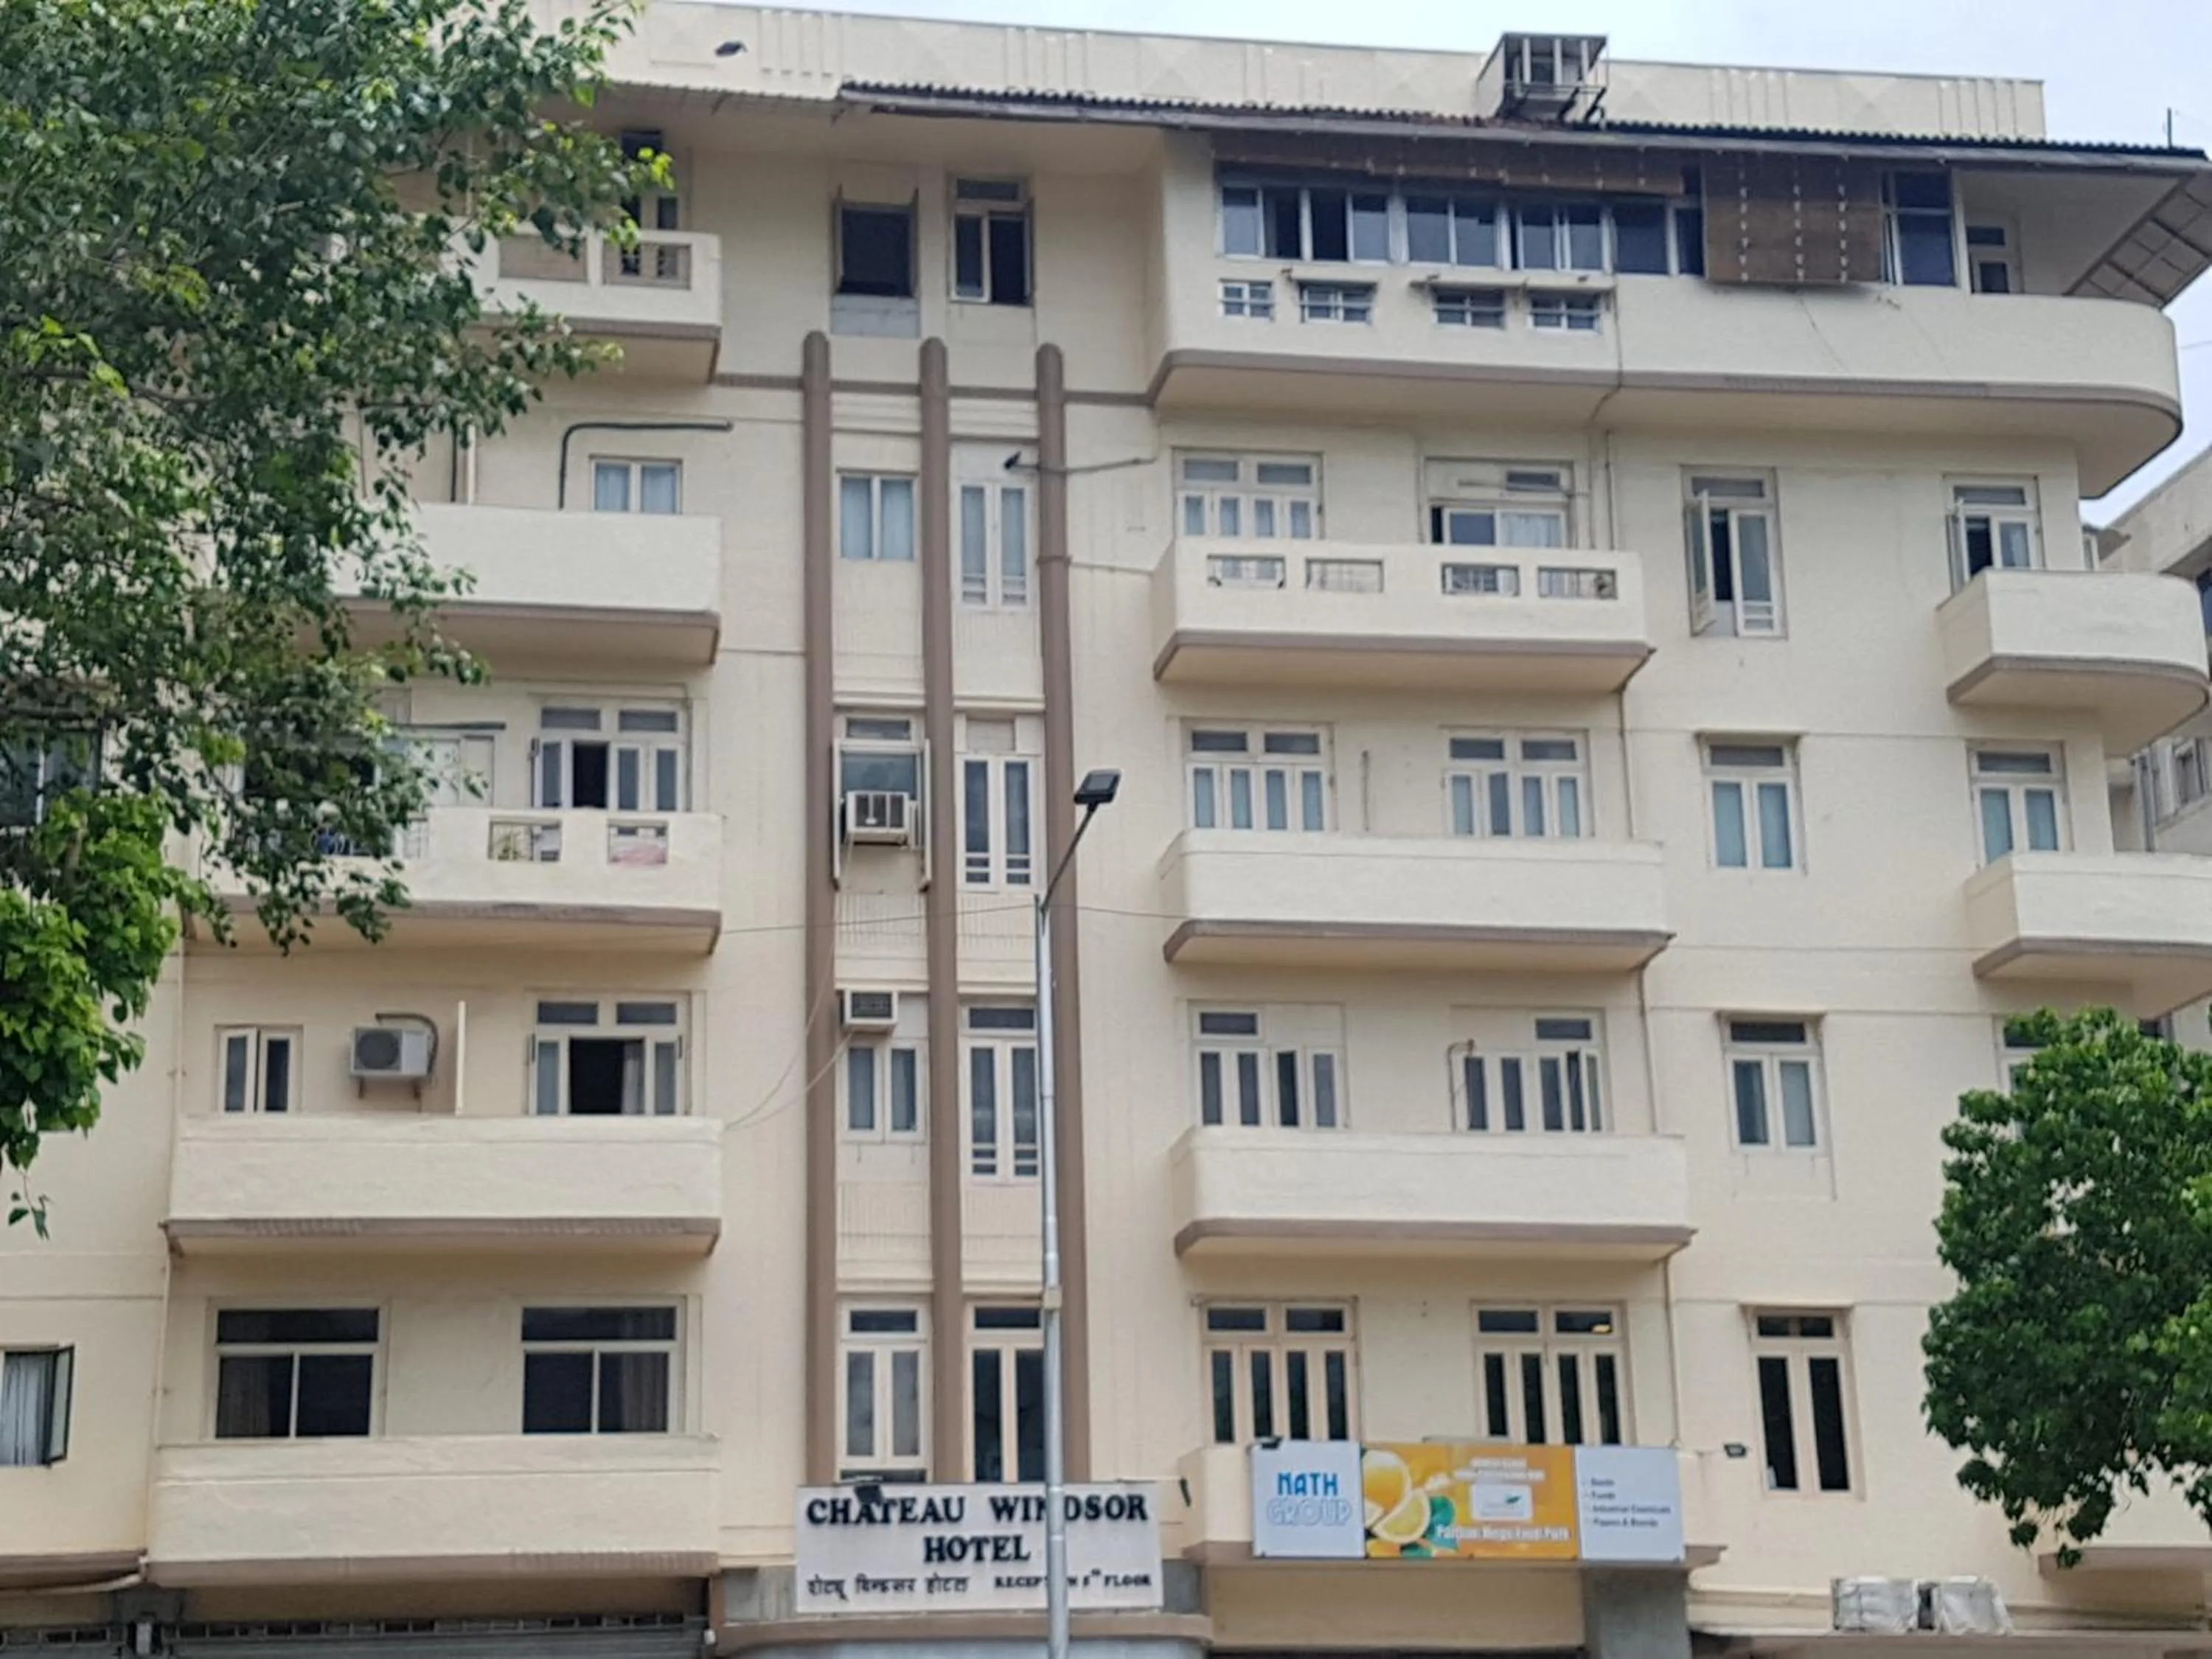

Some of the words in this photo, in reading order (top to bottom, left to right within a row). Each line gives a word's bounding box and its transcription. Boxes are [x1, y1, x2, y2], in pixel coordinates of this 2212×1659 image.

[1278, 1472, 1338, 1496] NATH
[807, 1496, 965, 1525] CHATEAU
[1267, 1497, 1353, 1526] GROUP
[924, 1535, 1031, 1562] HOTEL
[995, 1576, 1077, 1587] RECEPN
